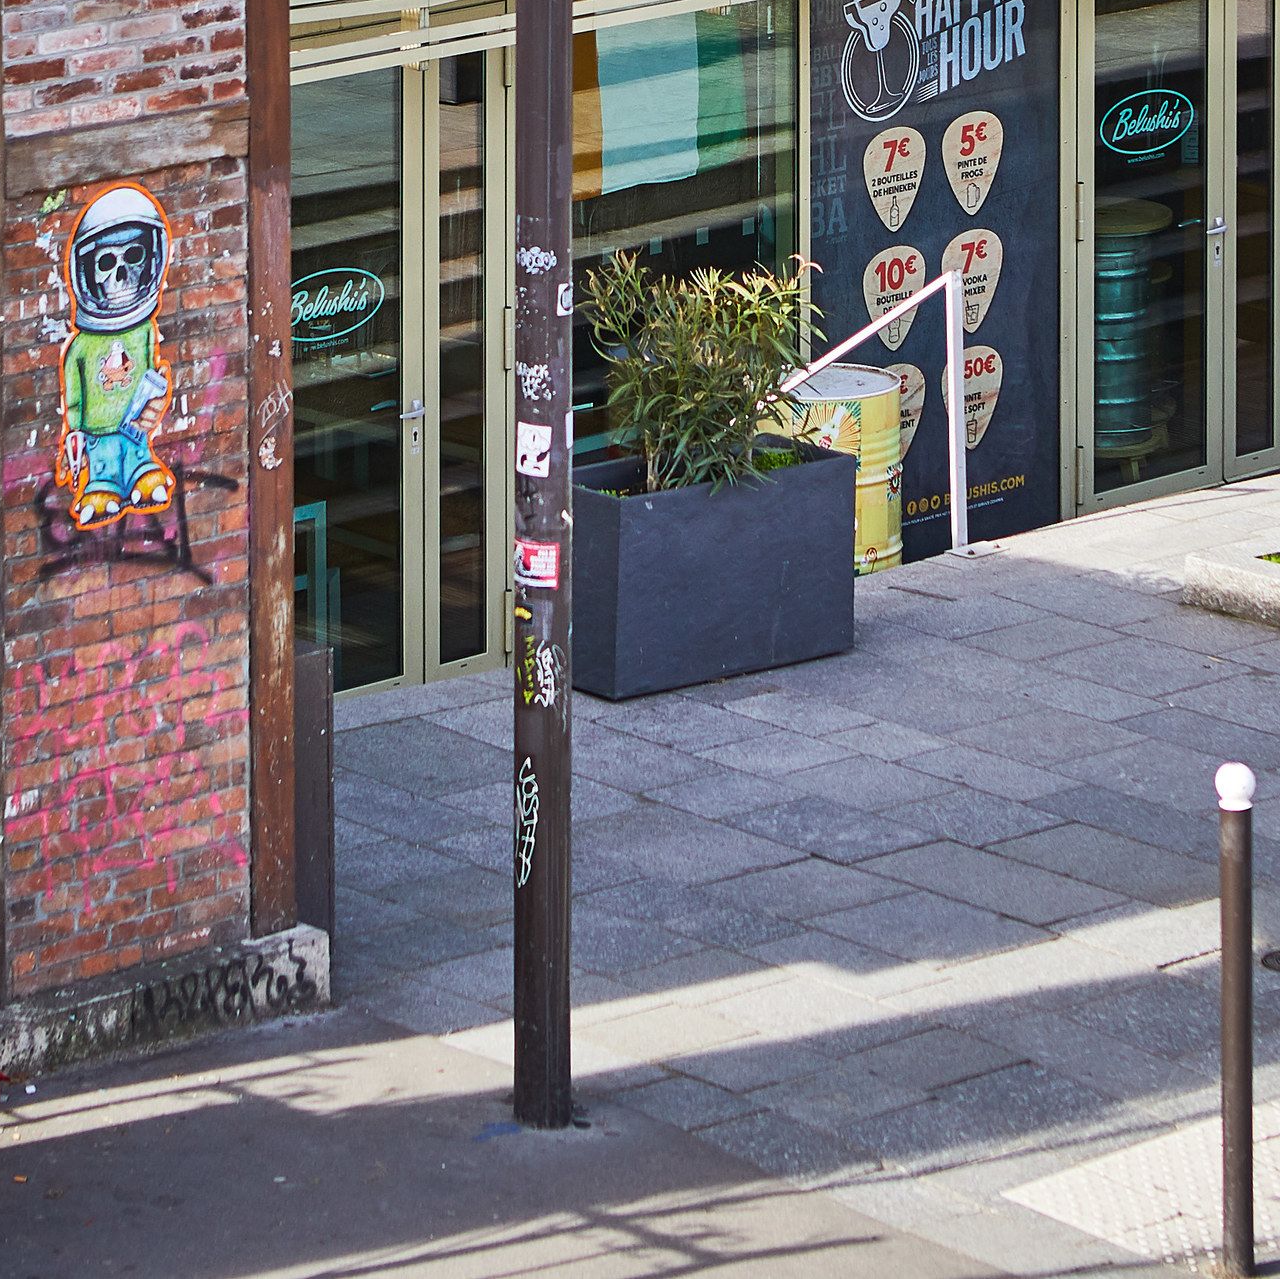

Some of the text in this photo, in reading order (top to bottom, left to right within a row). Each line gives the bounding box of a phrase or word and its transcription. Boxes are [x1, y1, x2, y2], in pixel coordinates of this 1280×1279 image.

[1111, 98, 1181, 143] Belushi's
[959, 121, 988, 157] 5€
[883, 137, 910, 173] 7€
[957, 155, 988, 170] PINTE DE
[872, 170, 918, 187] 2 BOUTEILLES
[873, 181, 917, 198] DE HEINEKEN
[961, 239, 988, 274] 7€
[874, 254, 917, 293] 10€
[963, 273, 988, 286] VODKA
[964, 286, 986, 297] MIXER
[964, 353, 996, 380] 50€
[968, 402, 986, 414] SOFT
[944, 474, 1025, 506] BUSHIS.COM
